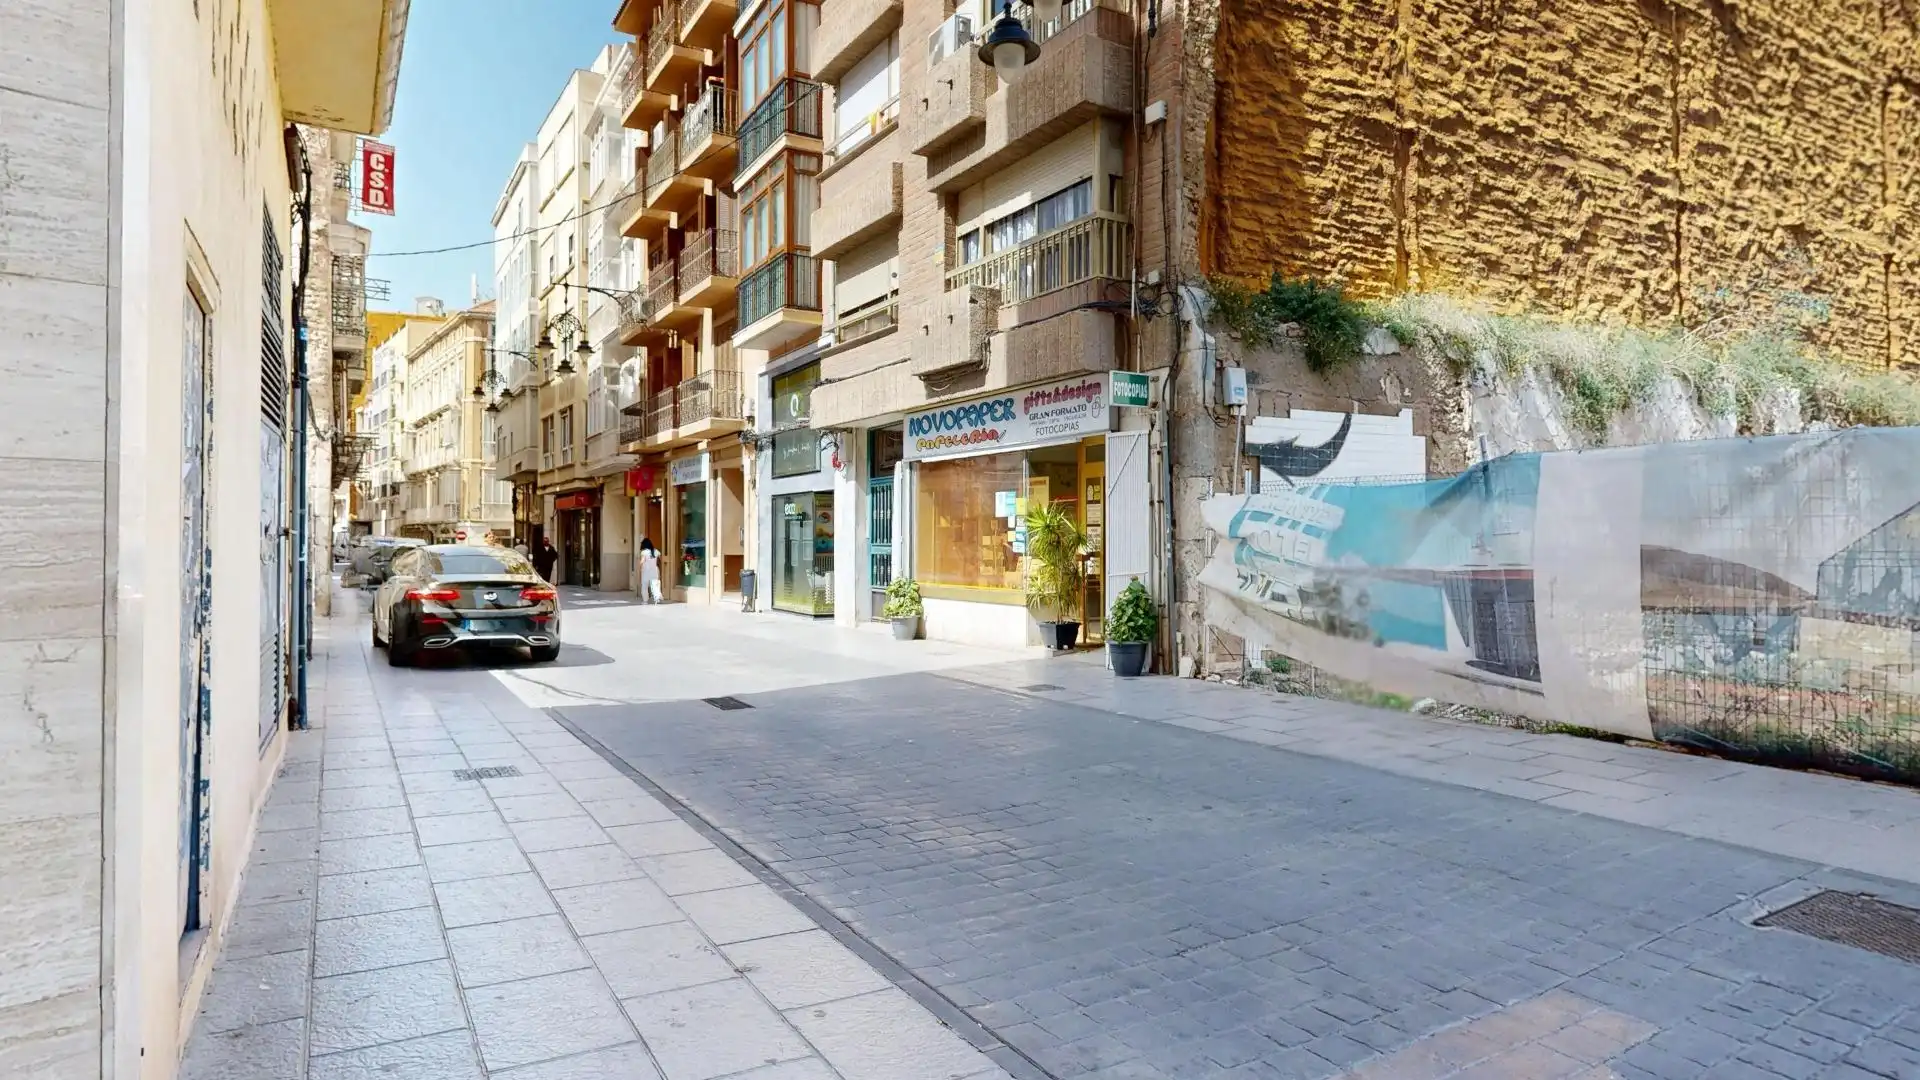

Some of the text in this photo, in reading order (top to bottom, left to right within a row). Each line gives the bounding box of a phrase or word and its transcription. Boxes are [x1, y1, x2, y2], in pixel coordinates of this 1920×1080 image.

[1114, 381, 1148, 399] FOTOCOPIAS
[908, 398, 1016, 437] NOVOPAPER
[1029, 411, 1051, 421] GRAN
[1050, 403, 1087, 417] FORMATO
[1035, 421, 1080, 437] FOTOCOPIAS
